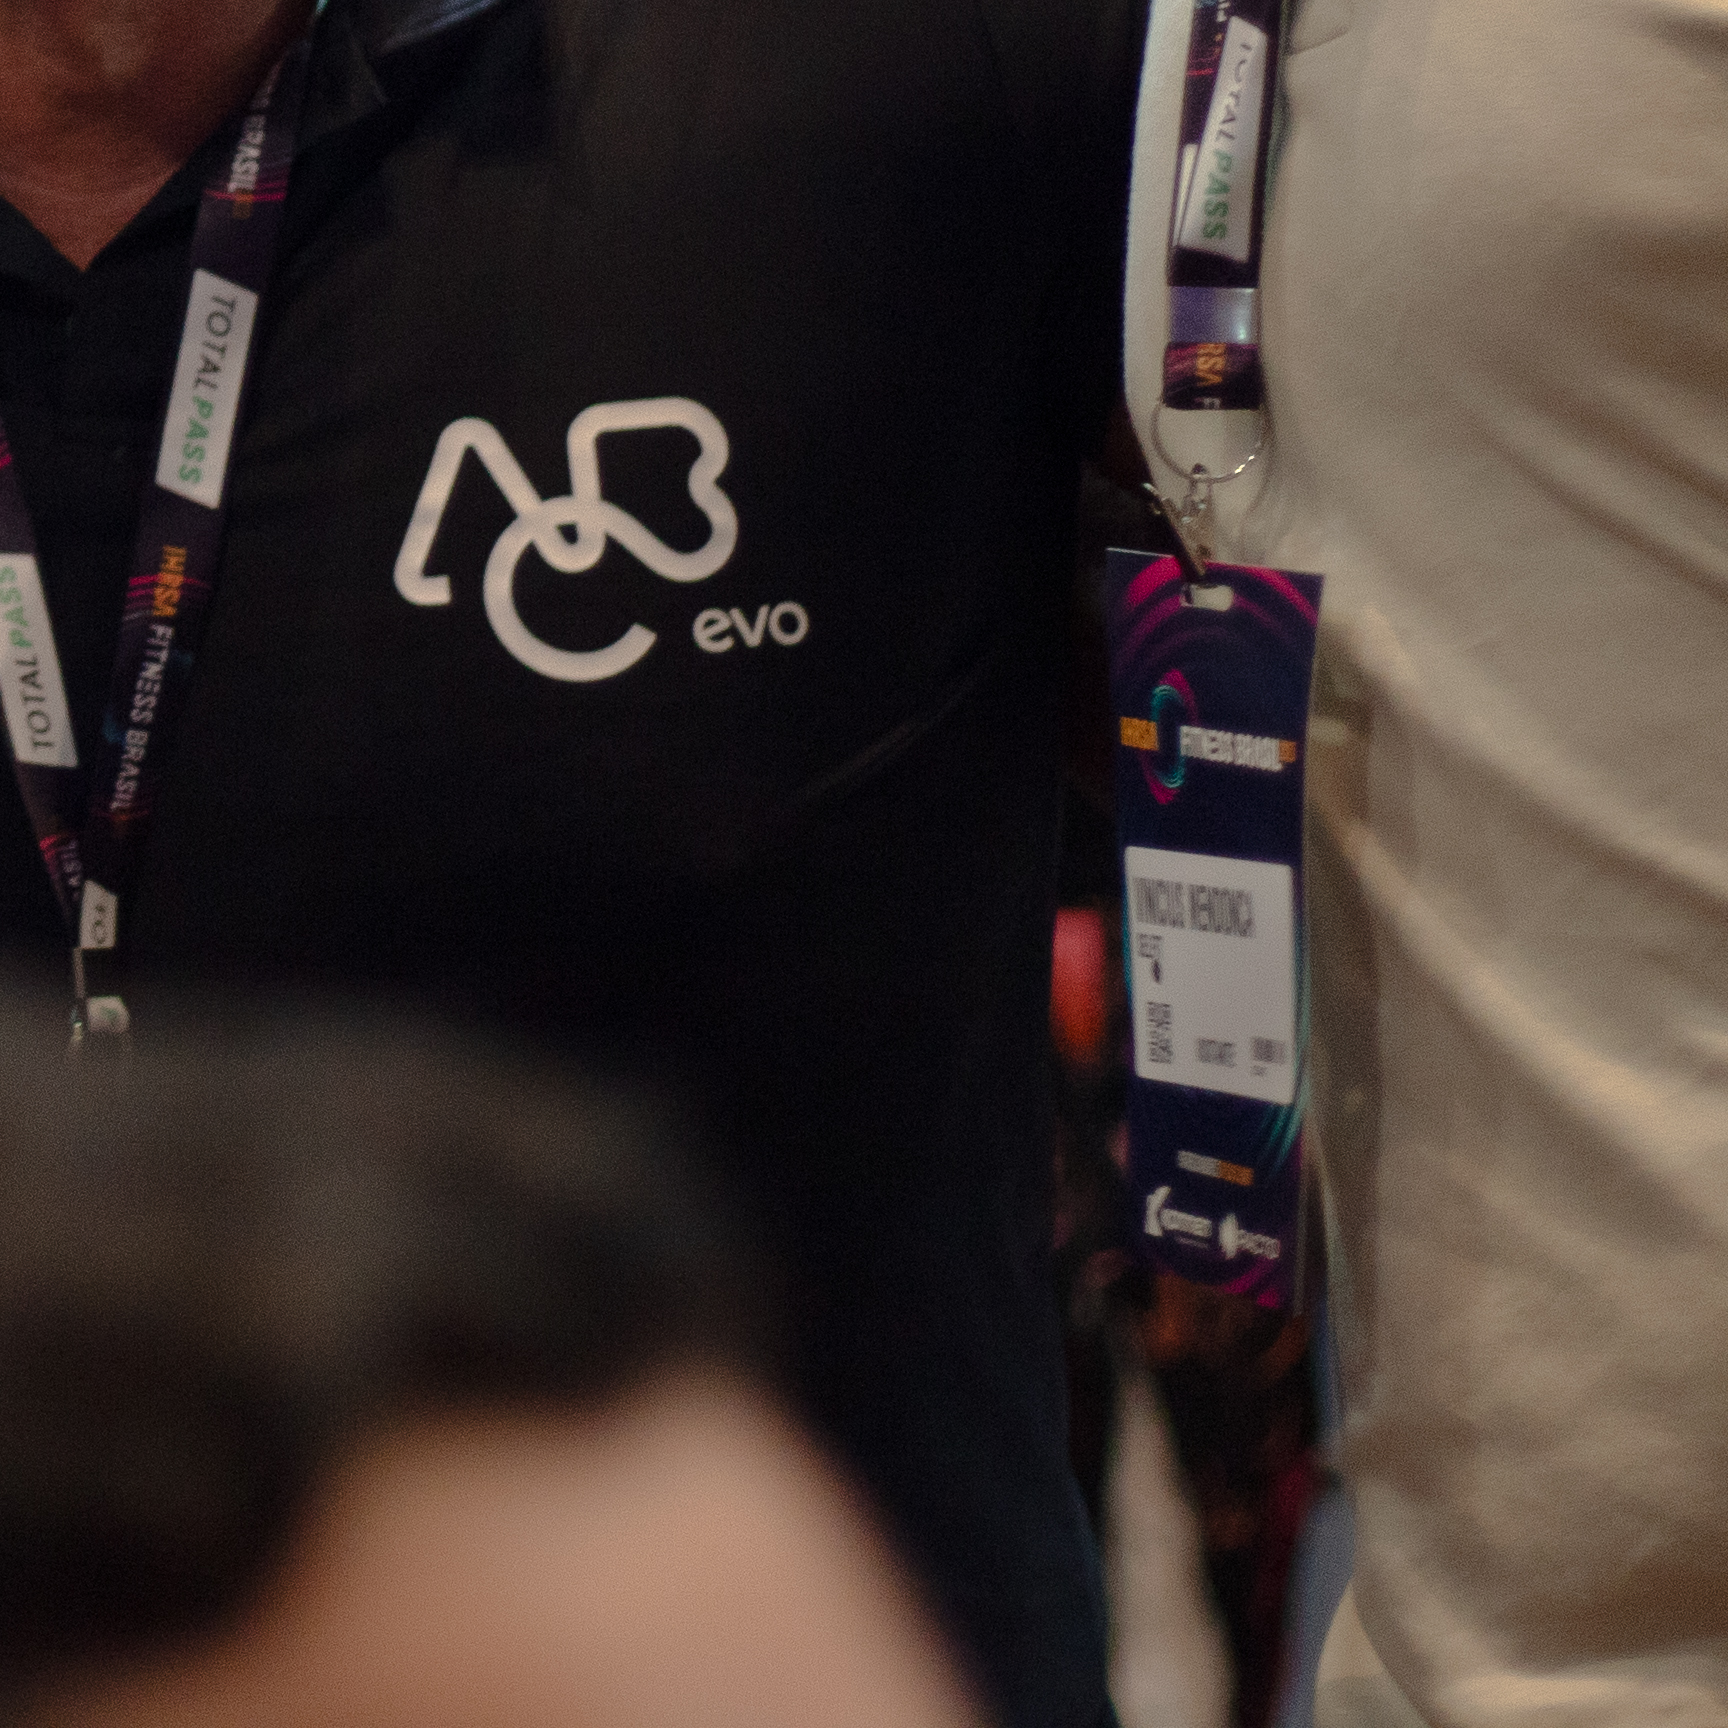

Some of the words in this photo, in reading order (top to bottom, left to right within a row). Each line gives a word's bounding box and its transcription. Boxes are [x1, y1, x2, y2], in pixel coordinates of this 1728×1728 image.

[179, 293, 237, 483] TOTALPASS
[152, 545, 187, 617] IHRSA
[692, 600, 810, 654] evo
[130, 623, 174, 722] FITNESS
[110, 729, 149, 811] BRASIL
